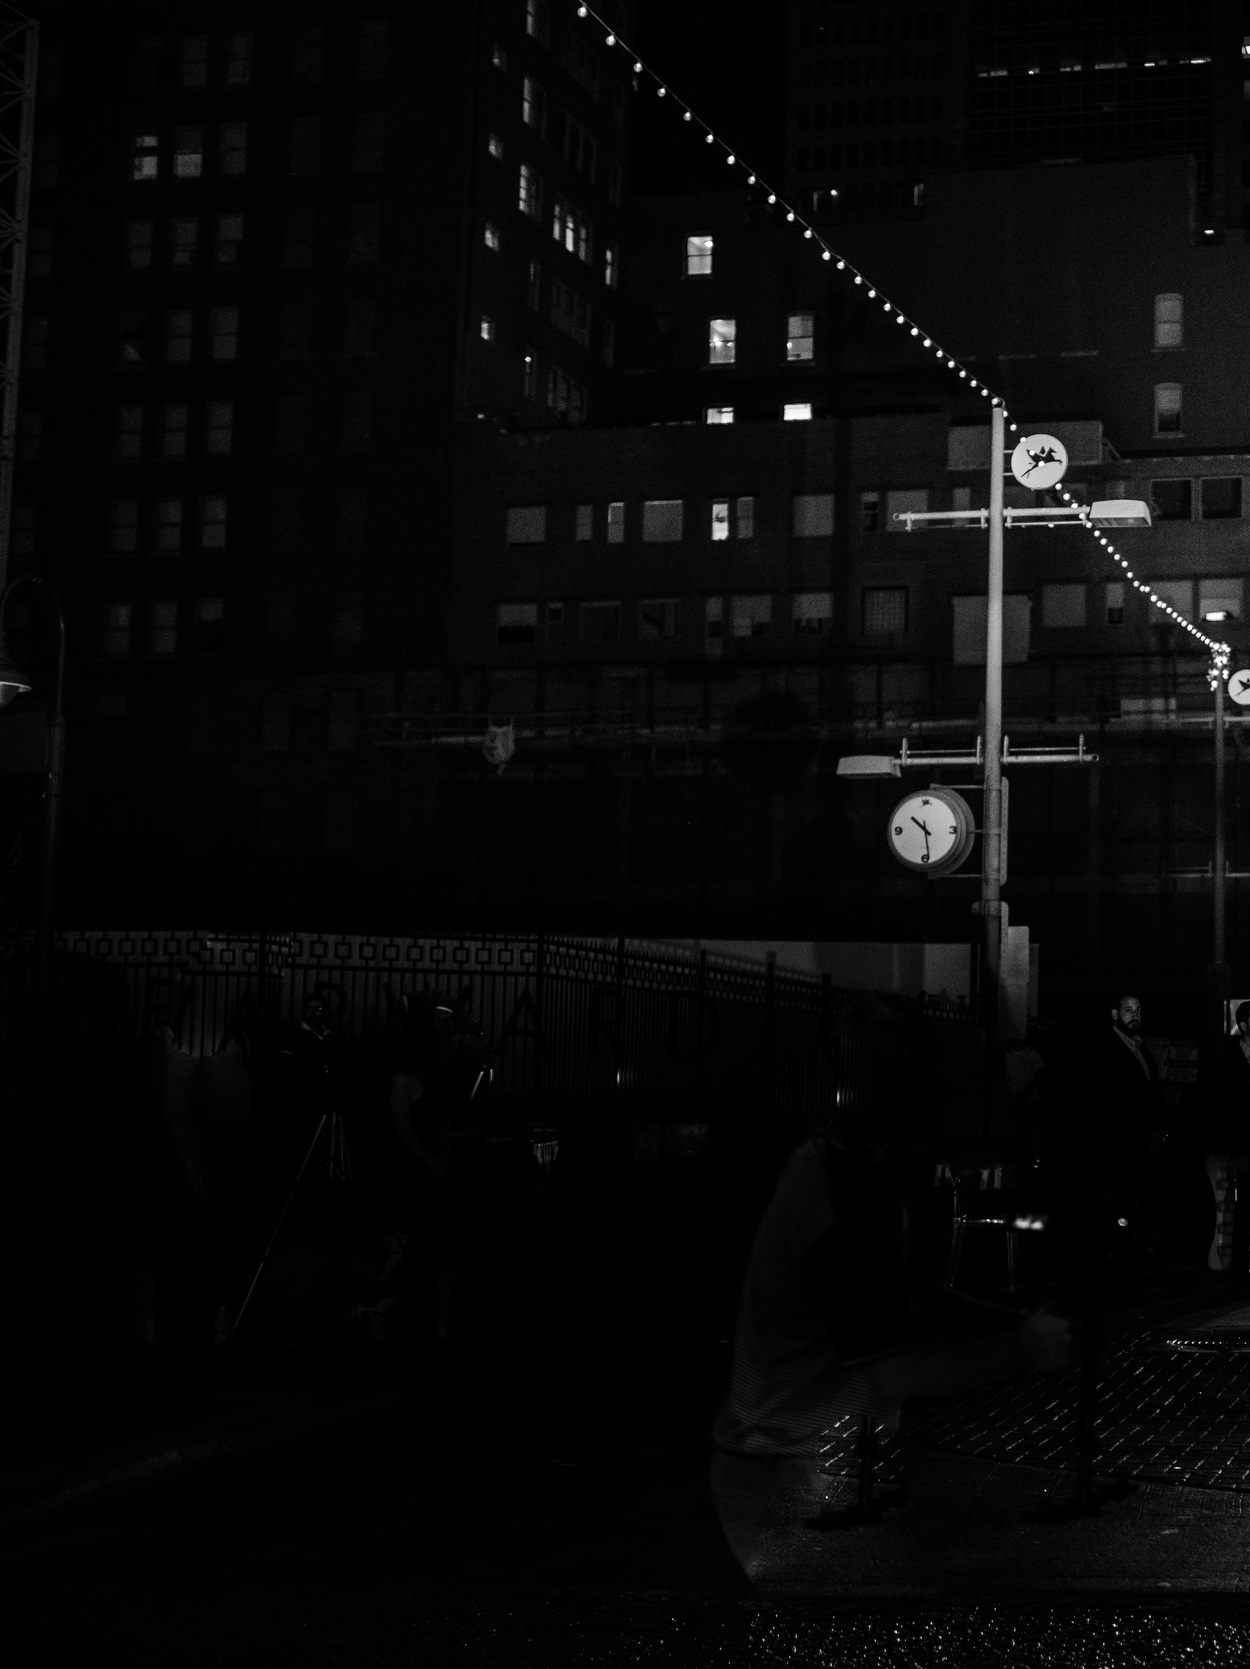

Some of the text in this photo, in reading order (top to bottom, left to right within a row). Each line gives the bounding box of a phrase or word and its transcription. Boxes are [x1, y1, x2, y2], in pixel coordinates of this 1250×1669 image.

[894, 826, 902, 835] 9
[949, 826, 957, 835] 3
[921, 854, 929, 863] 6
